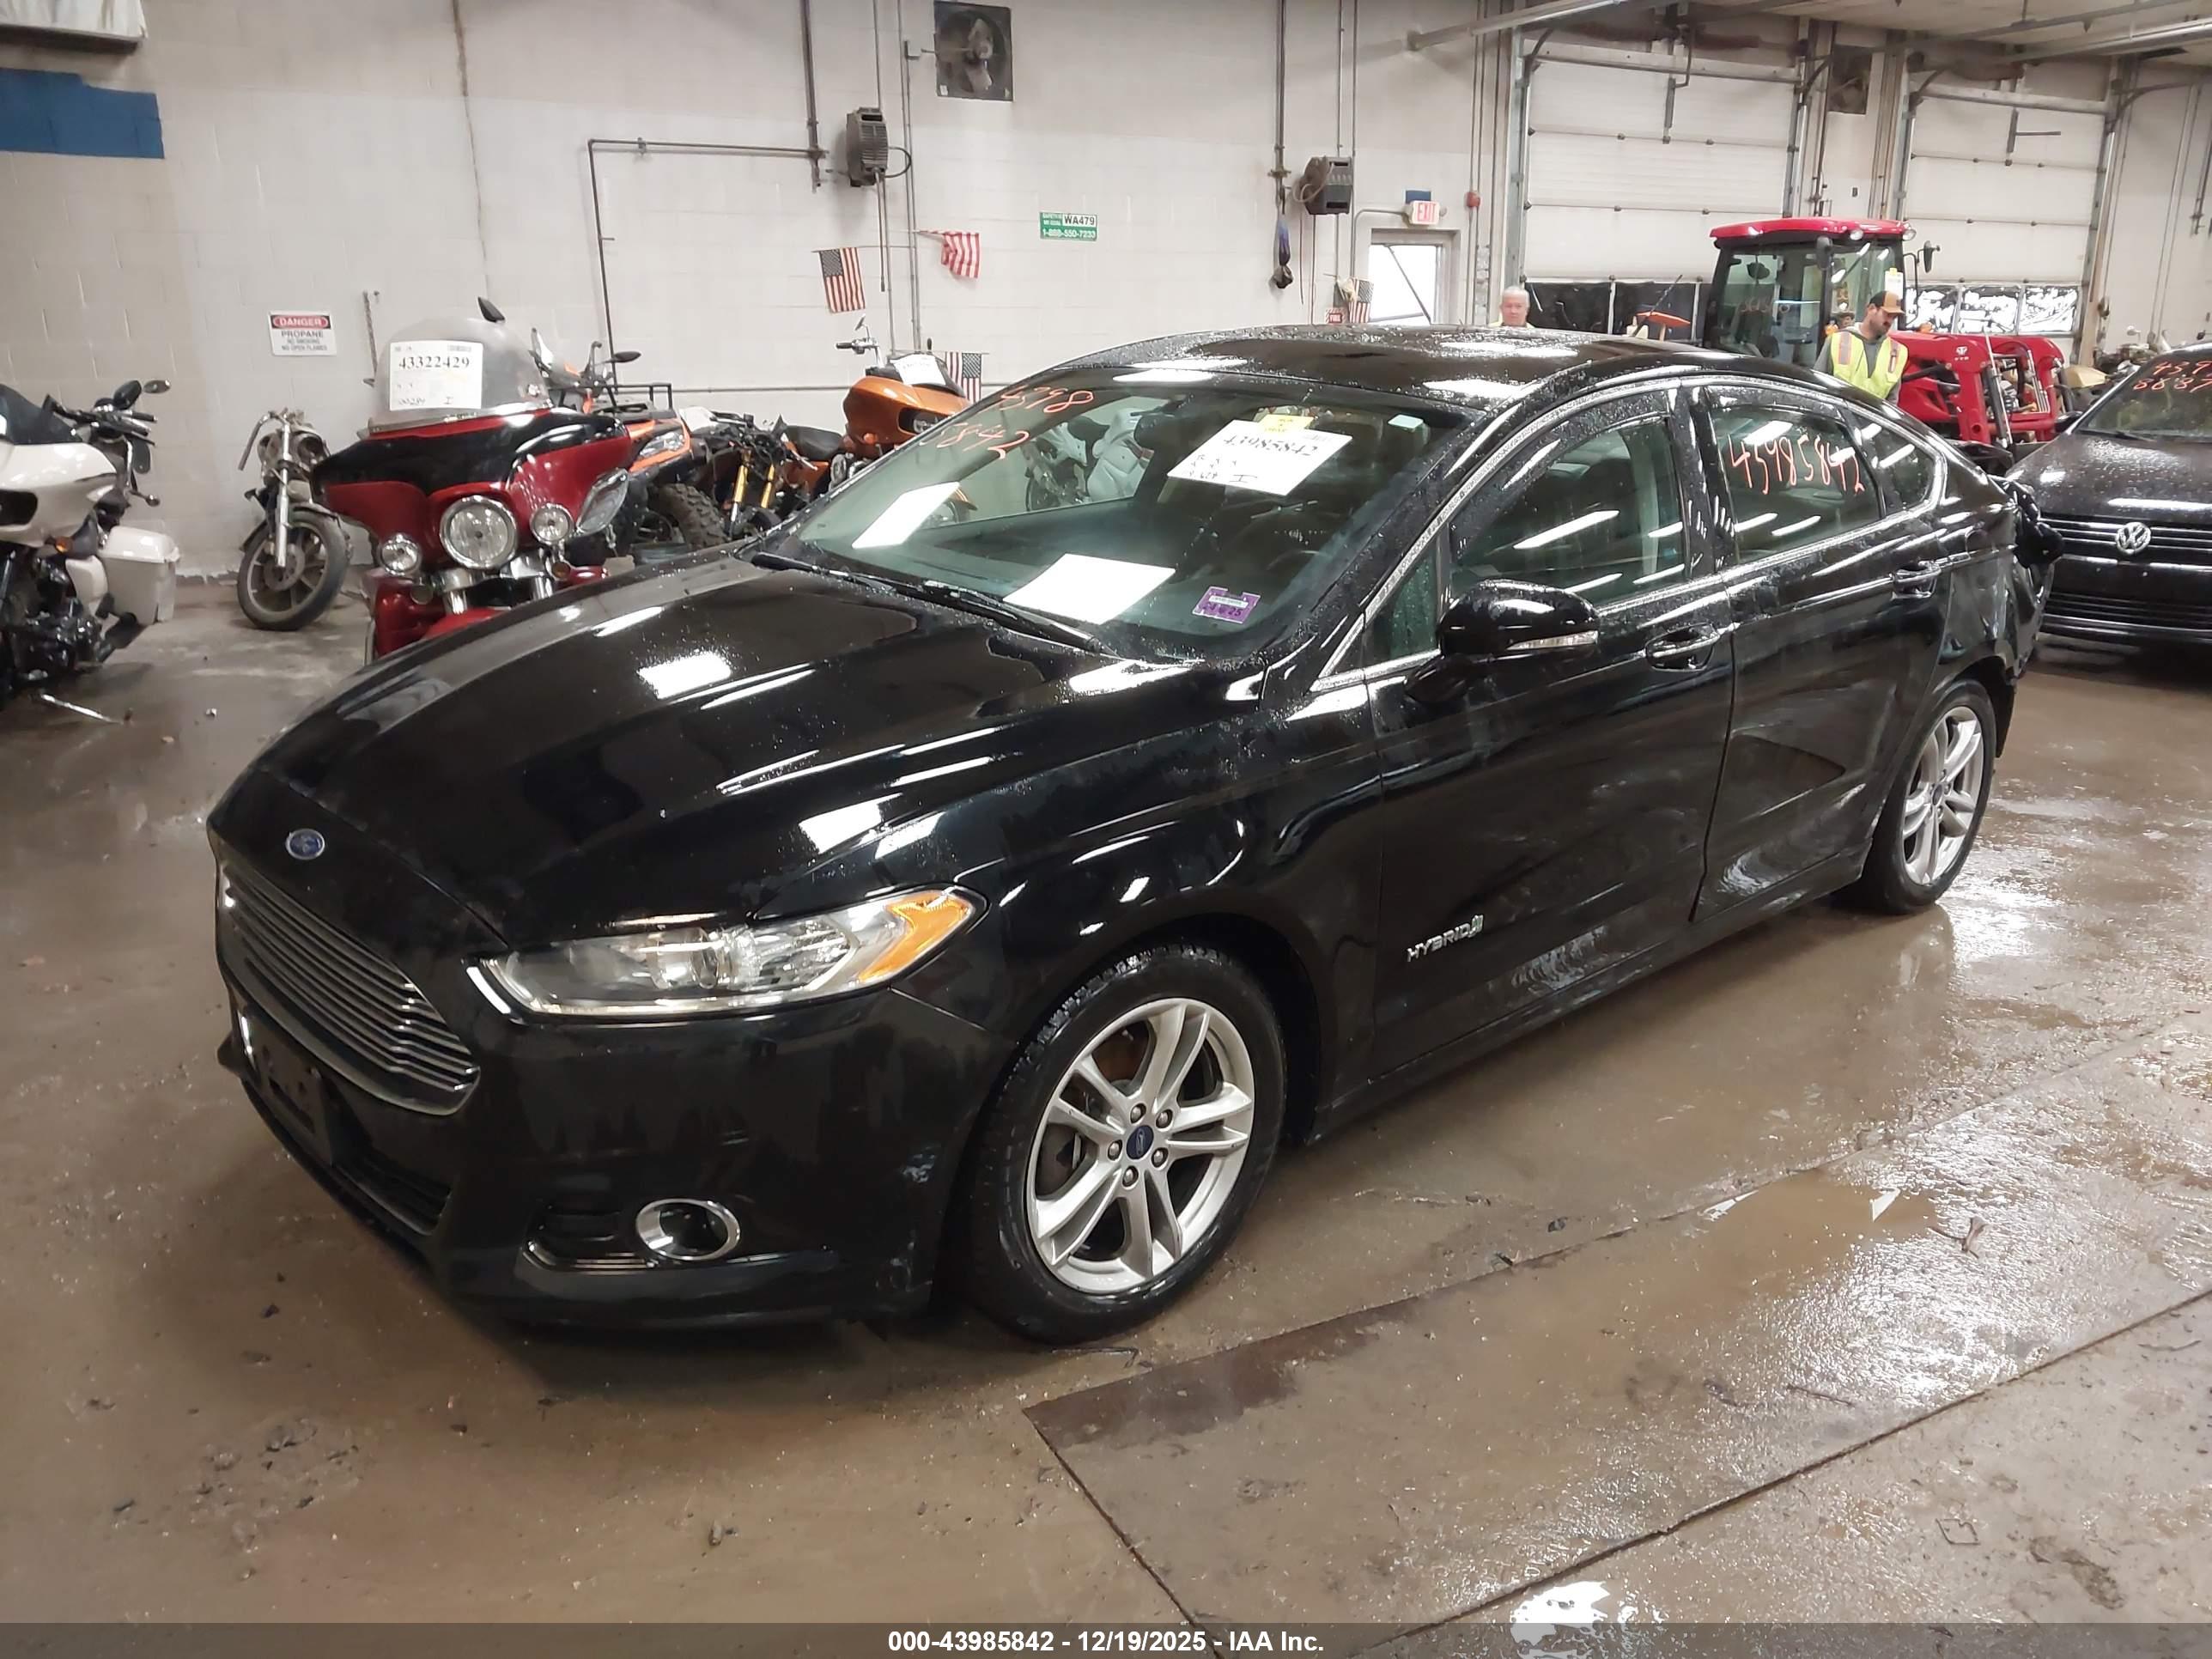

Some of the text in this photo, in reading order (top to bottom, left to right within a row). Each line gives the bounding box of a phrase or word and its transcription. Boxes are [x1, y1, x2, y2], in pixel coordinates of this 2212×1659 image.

[1417, 203, 1437, 222] EXIT
[1064, 216, 1096, 225] WA479
[279, 317, 321, 326] DANGER
[398, 356, 470, 370] 43322429
[1407, 922, 1471, 963] HYBRID
